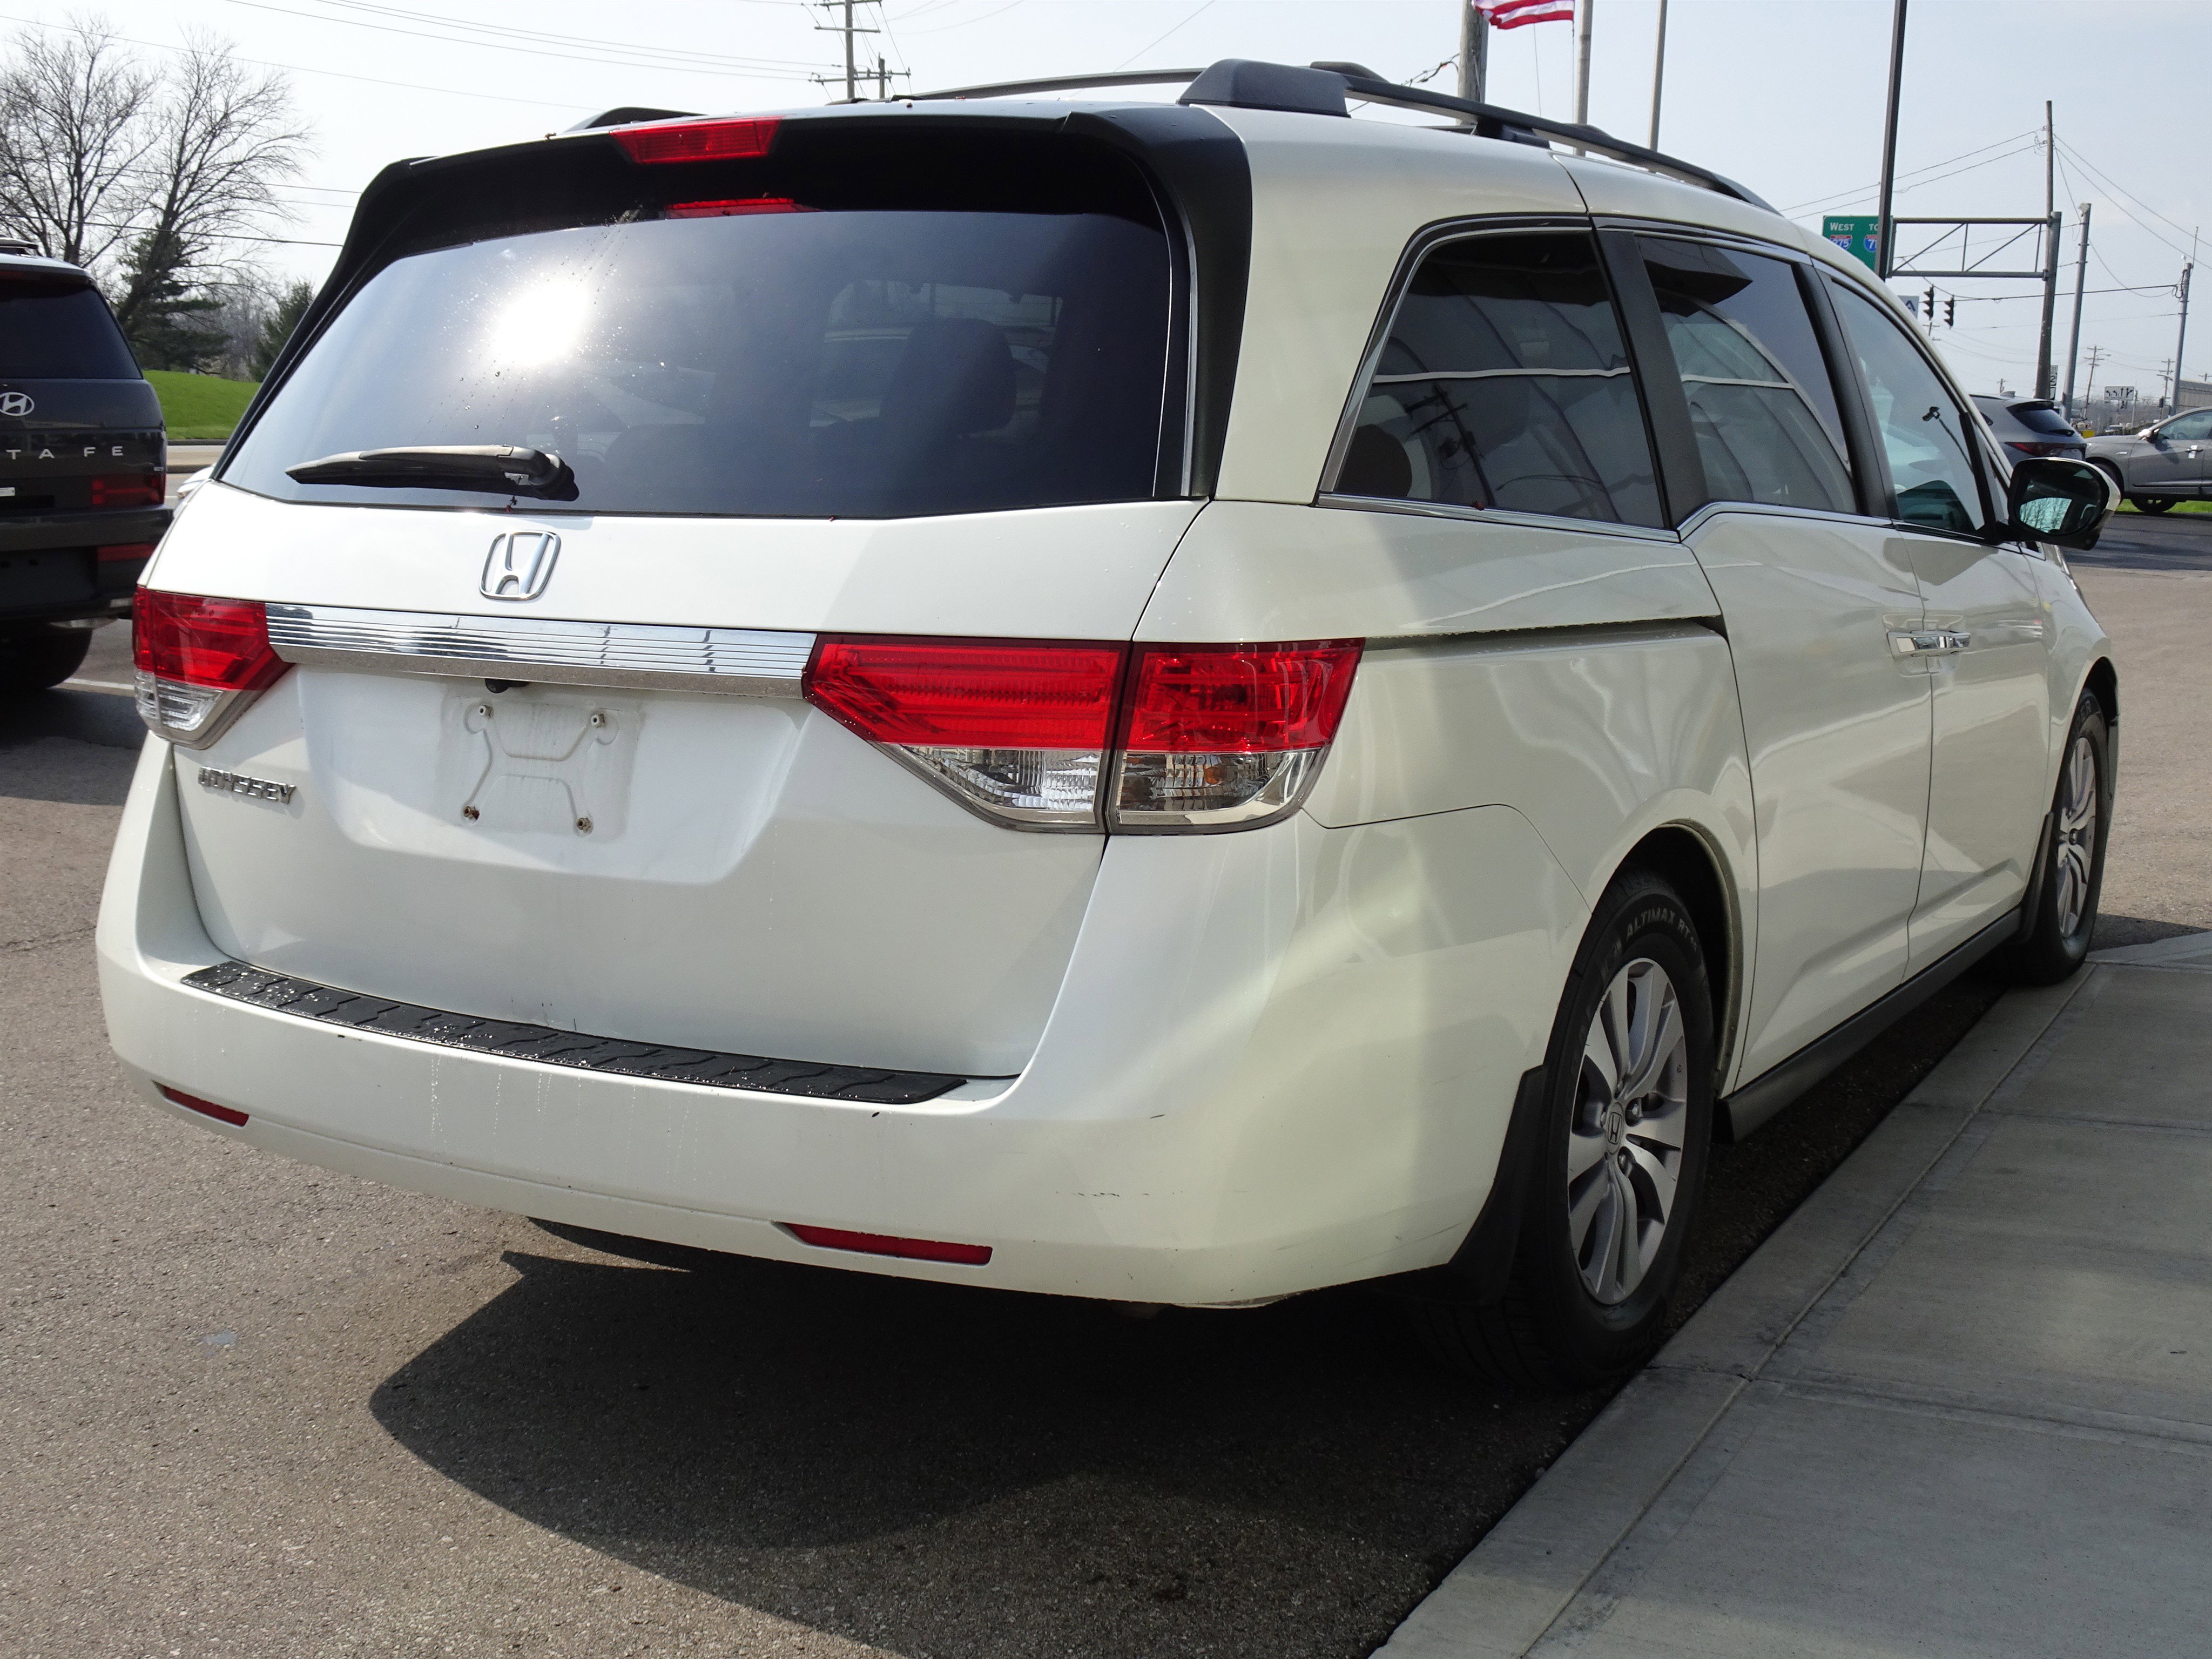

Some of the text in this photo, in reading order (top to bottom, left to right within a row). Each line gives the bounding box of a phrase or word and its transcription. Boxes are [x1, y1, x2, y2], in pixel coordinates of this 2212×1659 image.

[1830, 222, 1854, 231] WEST
[6, 446, 124, 460] TA FE
[1626, 908, 1675, 942] ALTIMAX
